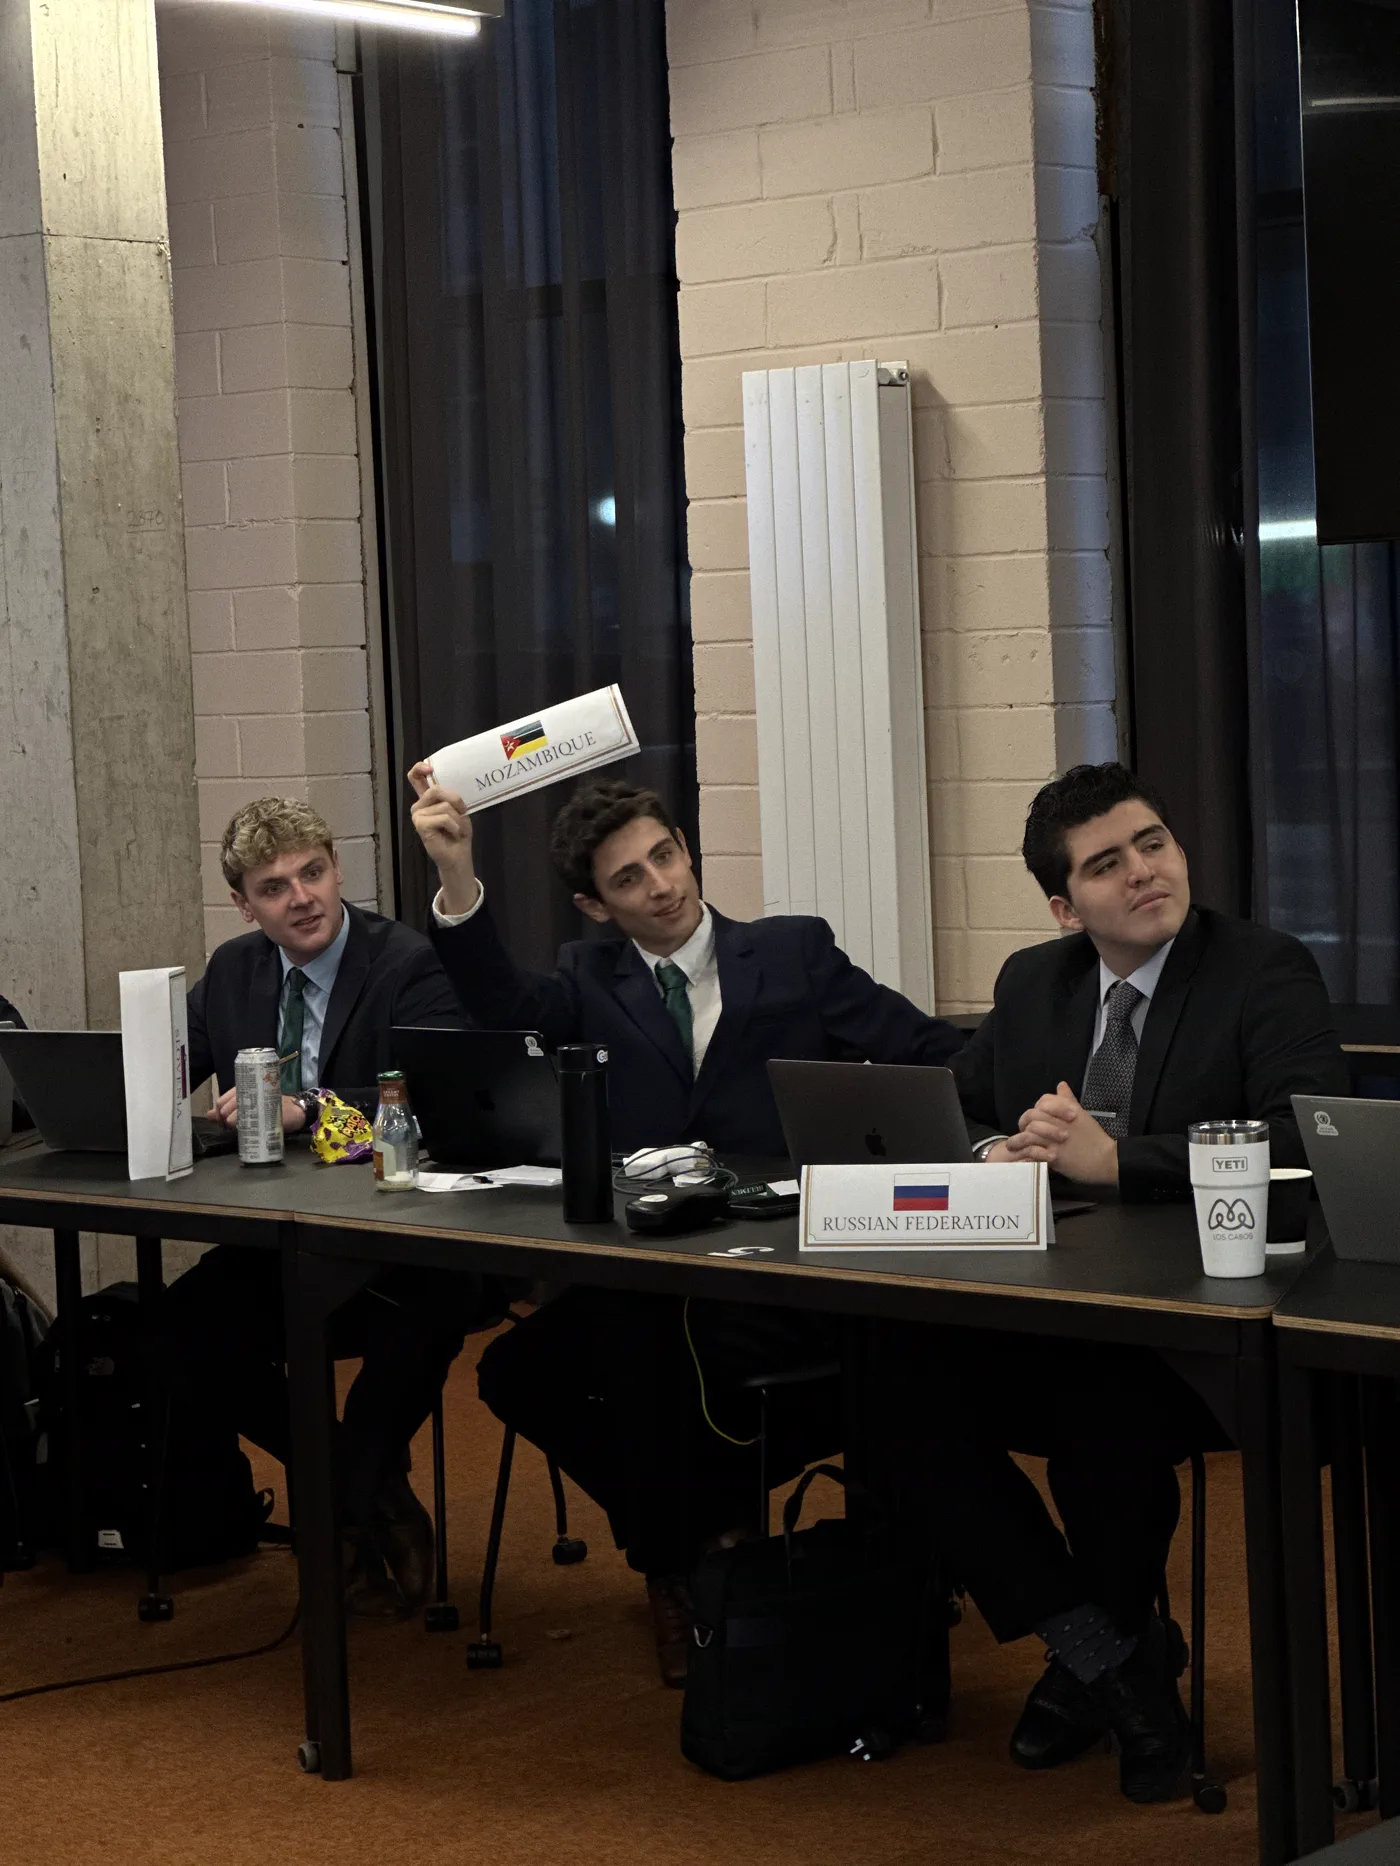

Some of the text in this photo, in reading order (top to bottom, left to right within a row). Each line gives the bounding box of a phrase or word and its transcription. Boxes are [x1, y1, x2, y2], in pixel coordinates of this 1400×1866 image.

[475, 731, 597, 791] MOZAMBIQUE
[173, 1028, 182, 1119] SLOVENIA
[1215, 1159, 1245, 1170] YETI
[823, 1215, 1021, 1232] RUSSIAN FEDERATION
[1212, 1232, 1254, 1241] LOS CABOS
